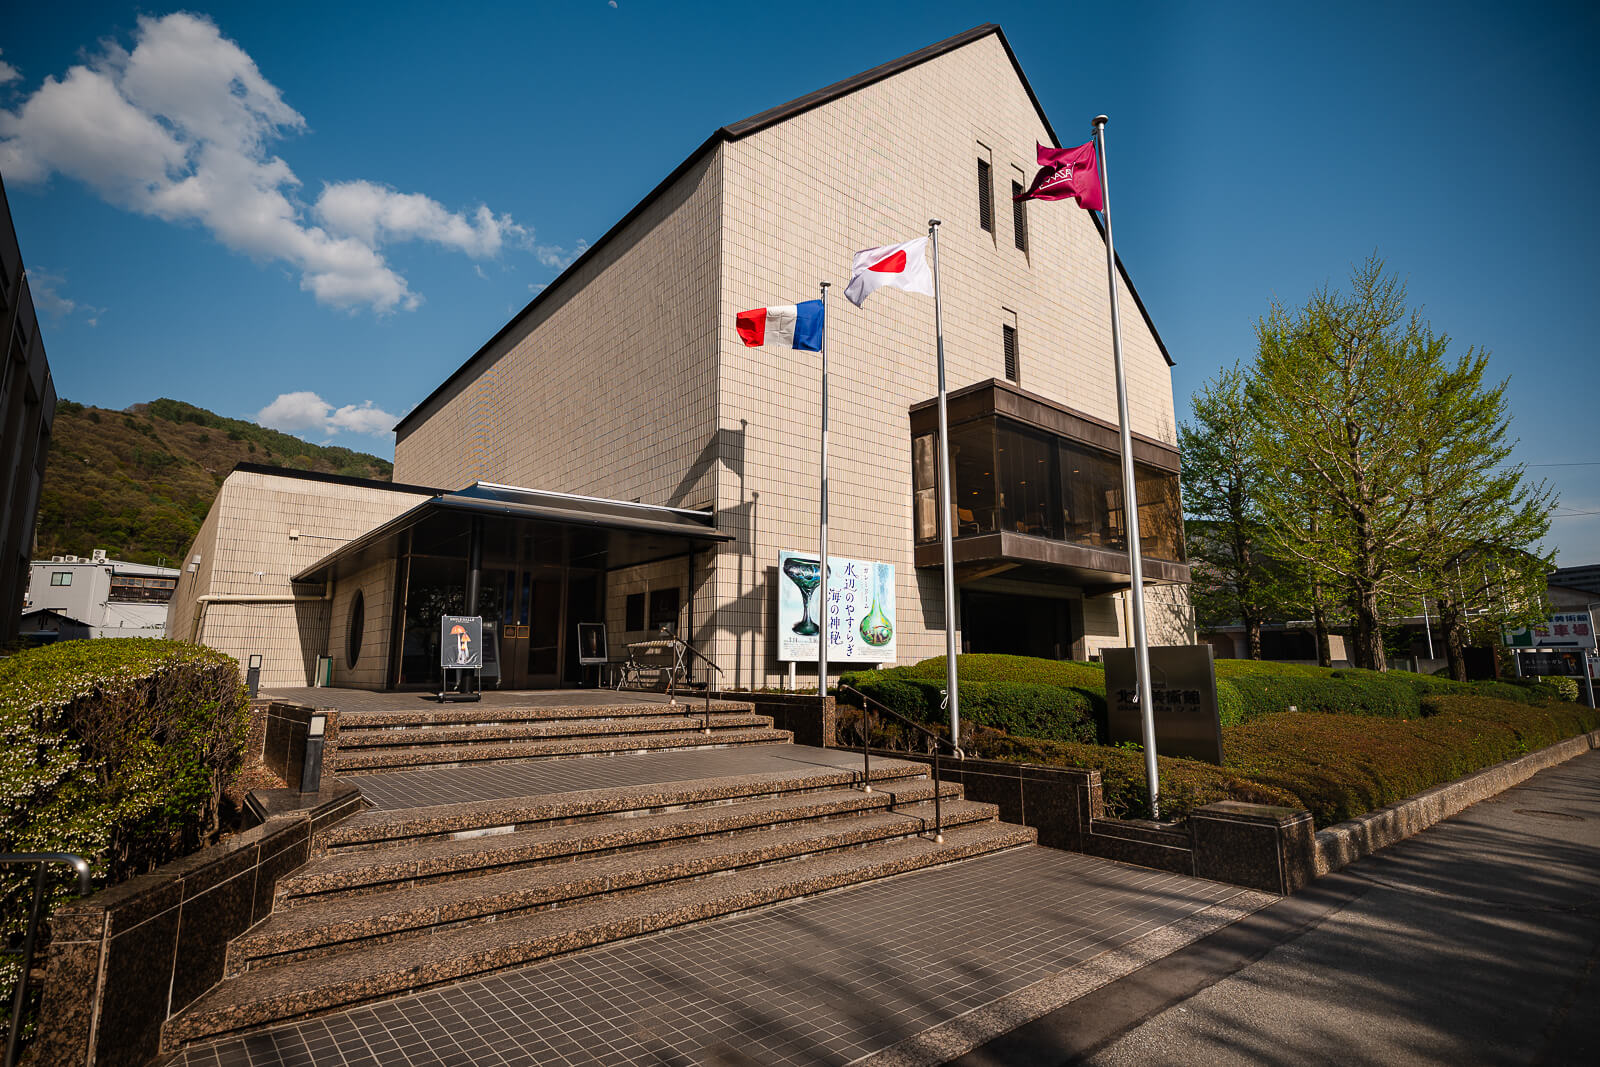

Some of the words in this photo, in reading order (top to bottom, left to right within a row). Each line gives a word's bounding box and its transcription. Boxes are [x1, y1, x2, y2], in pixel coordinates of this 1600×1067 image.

[828, 588, 843, 645] 海の神秘
[843, 562, 858, 657] 水辺のやすらぎ
